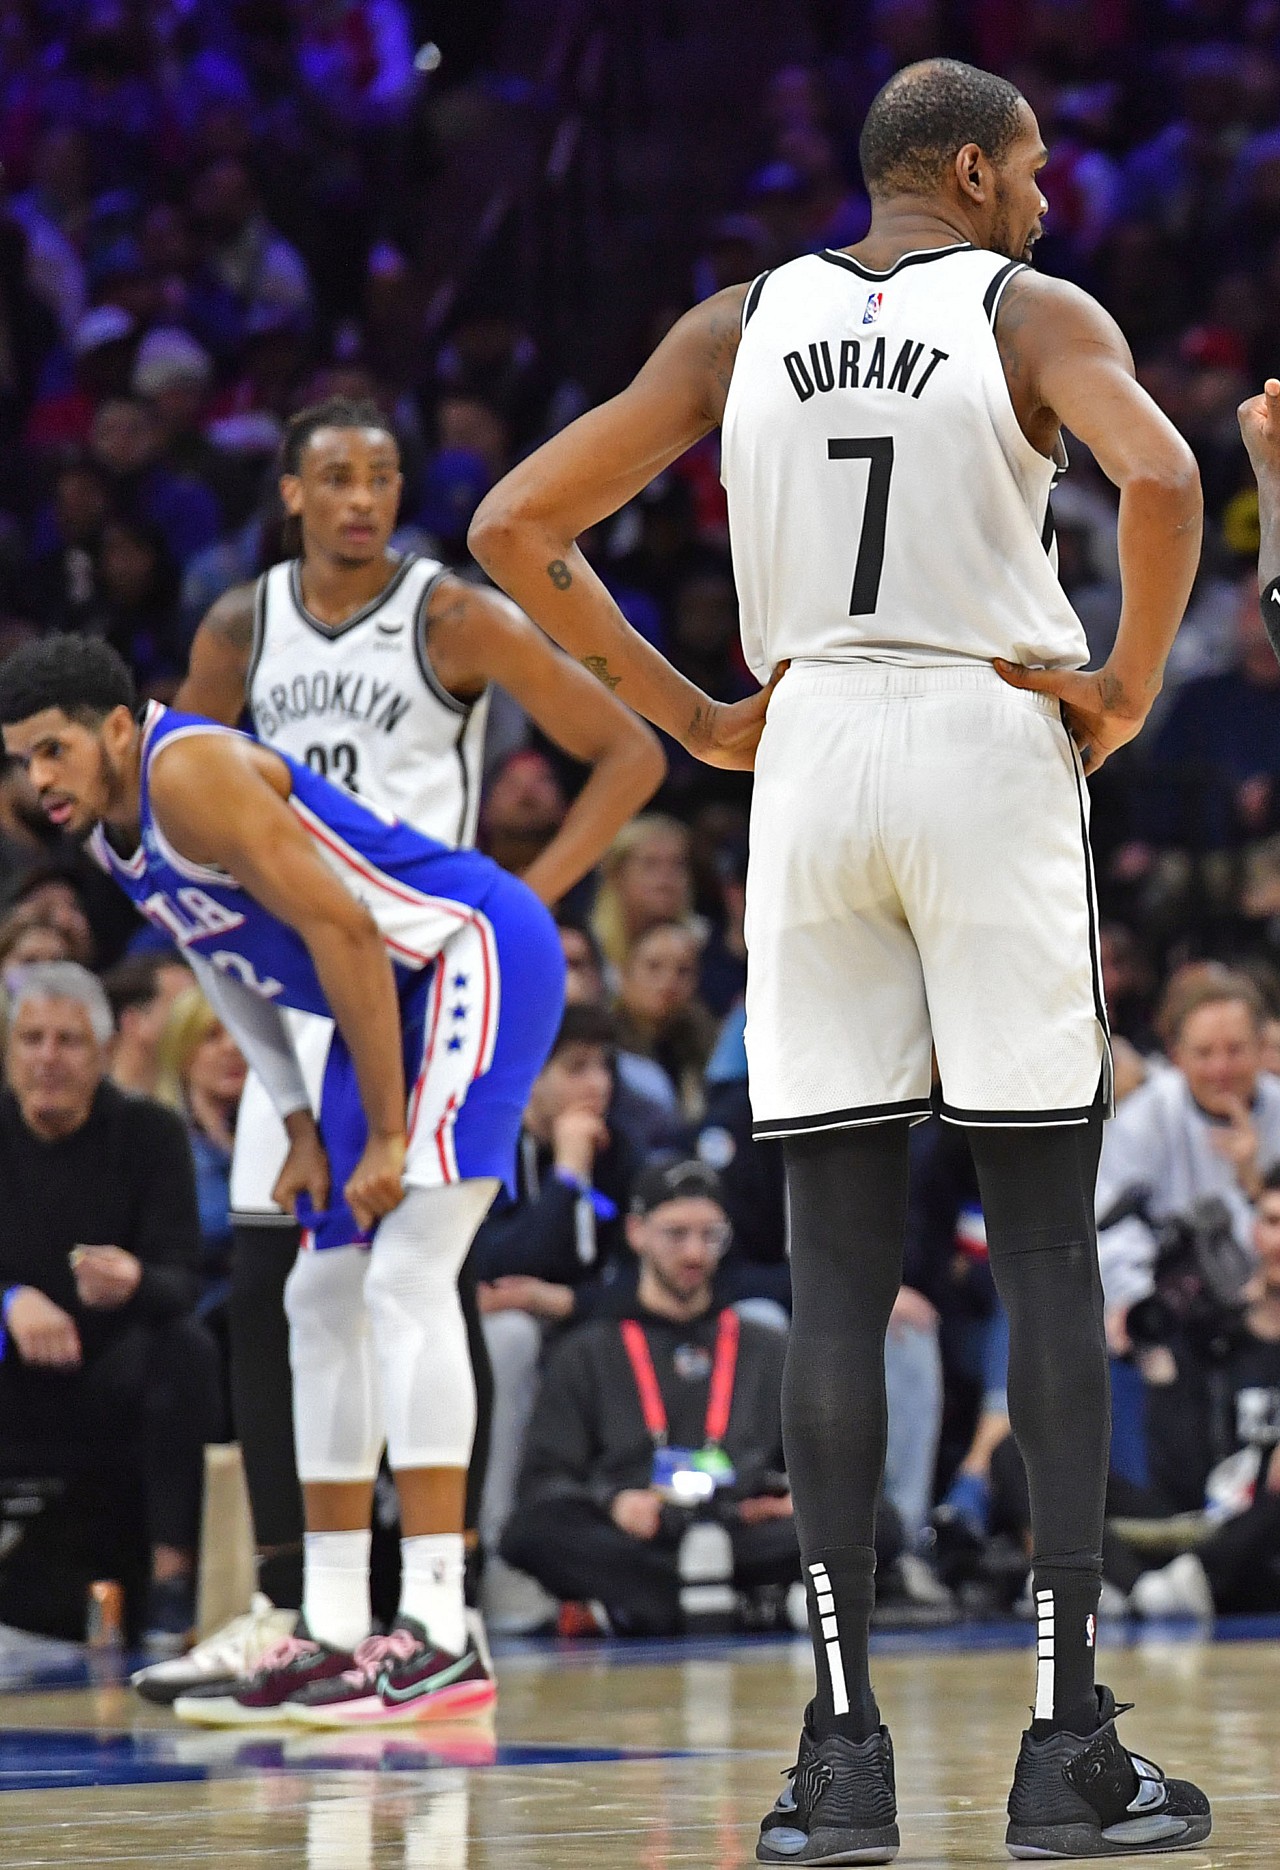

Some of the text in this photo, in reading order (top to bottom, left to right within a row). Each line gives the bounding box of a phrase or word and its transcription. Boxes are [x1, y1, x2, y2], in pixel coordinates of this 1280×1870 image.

[783, 337, 949, 402] DURANT
[827, 436, 894, 616] 7
[253, 670, 412, 737] BROOKLYN
